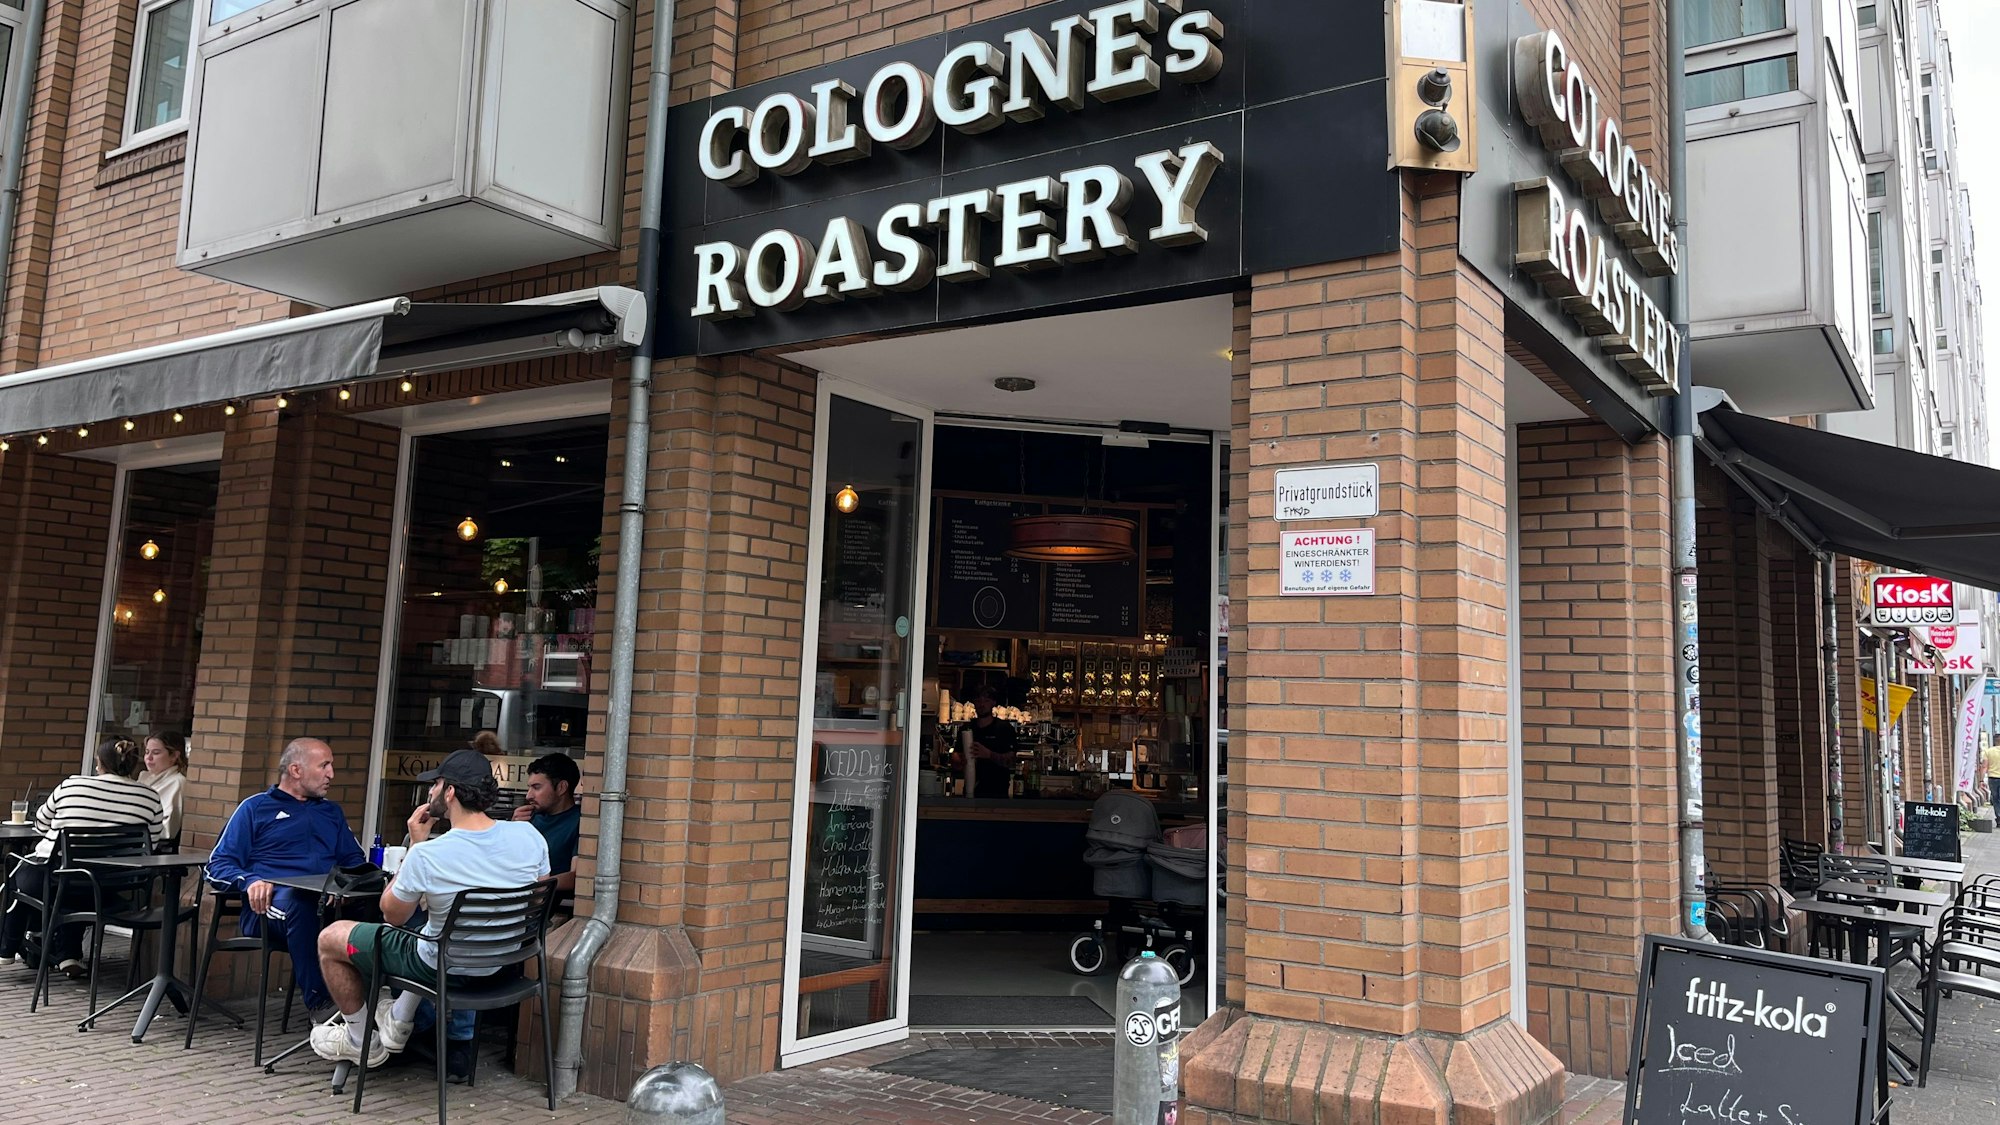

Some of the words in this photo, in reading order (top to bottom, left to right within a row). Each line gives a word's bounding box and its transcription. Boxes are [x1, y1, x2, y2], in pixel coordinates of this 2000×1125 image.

[691, 141, 1223, 318] ROASTERY
[1545, 175, 1680, 394] ROASTERY
[1279, 481, 1373, 504] Privatgrundstück
[1294, 535, 1353, 546] ACHTUNG
[1285, 547, 1369, 558] EINGESCHRÄNKTER
[1294, 559, 1360, 568] WINTERDIENST!
[1876, 583, 1951, 603] KiosK
[824, 749, 857, 777] ICED
[1667, 1024, 1742, 1073] Iced
